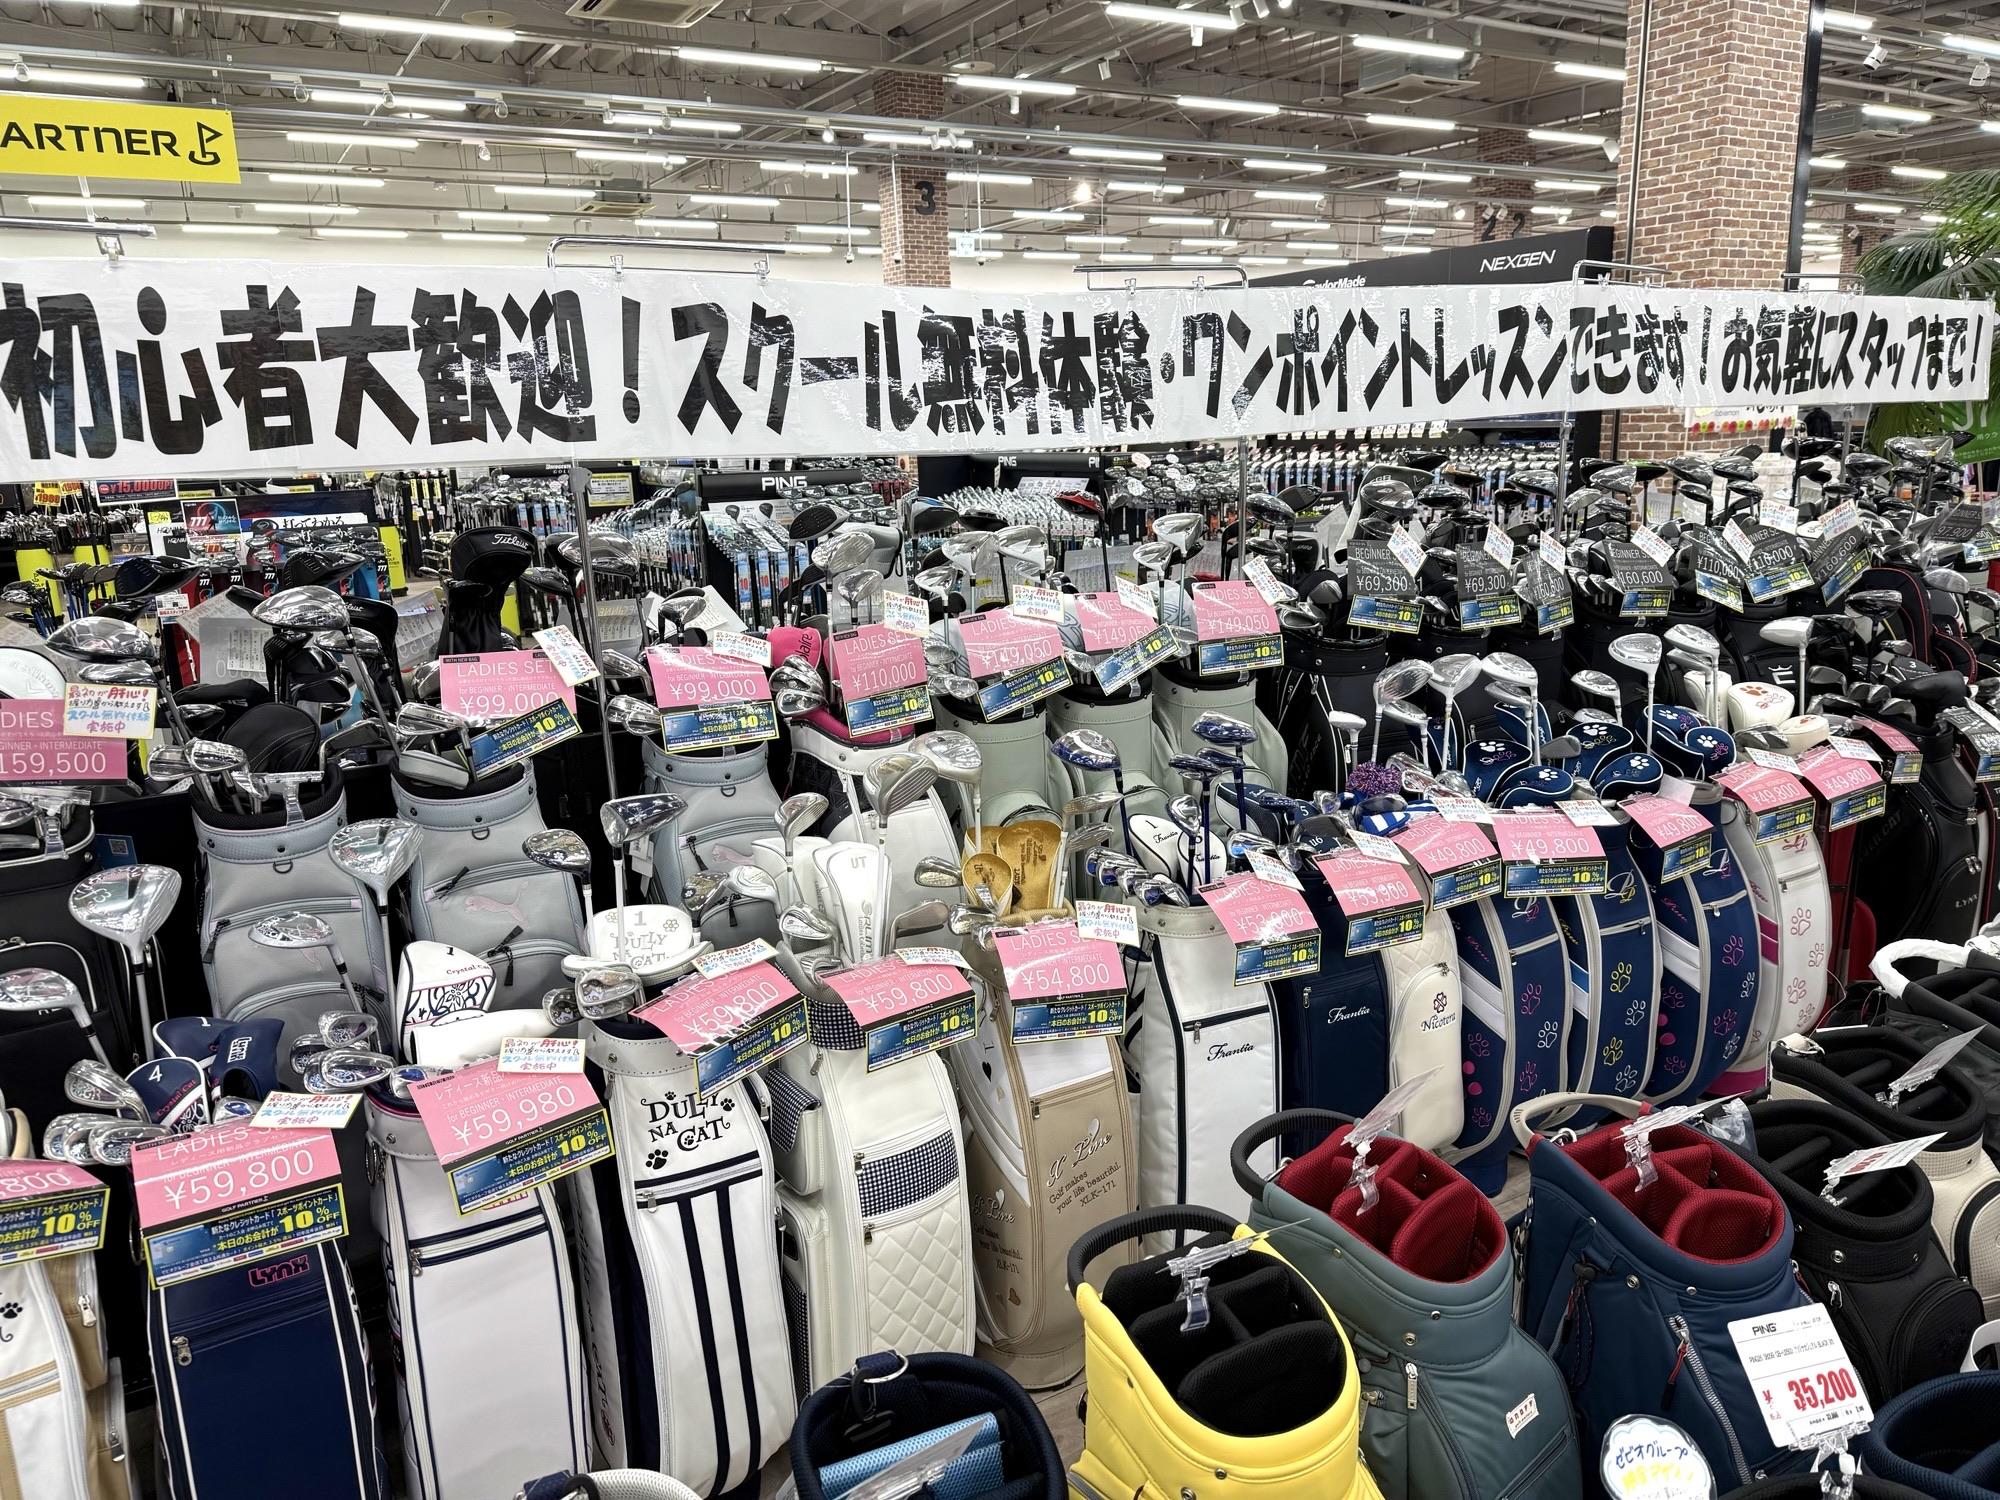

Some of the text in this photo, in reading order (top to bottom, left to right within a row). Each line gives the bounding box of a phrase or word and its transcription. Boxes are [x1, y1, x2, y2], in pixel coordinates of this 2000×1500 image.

[0, 121, 180, 157] ARTNER
[914, 180, 935, 216] 3
[1479, 250, 1556, 272] NEXGEN
[998, 456, 1017, 467] PING
[761, 475, 807, 491] PING
[491, 533, 528, 549] Titleist
[1465, 574, 1507, 593] ¥69,300
[1398, 610, 1412, 621] 10
[1499, 604, 1511, 614] 10
[457, 661, 518, 677] LADIES
[534, 716, 556, 734] 10
[1424, 838, 1486, 867] ¥49,800
[851, 856, 867, 871] UT
[1478, 871, 1491, 885] 10
[1572, 871, 1591, 883] 10
[1399, 919, 1413, 932] 10
[1010, 933, 1067, 951] LADIES
[1291, 948, 1308, 962] 10
[1021, 963, 1110, 991] ¥54,800
[865, 973, 953, 1014] ¥59,800
[940, 1015, 960, 1033] 10
[1087, 1009, 1108, 1024] 10
[1326, 1006, 1370, 1024] Frantia
[1420, 1013, 1456, 1032] Nicotera
[771, 1023, 792, 1043] 10
[1206, 1042, 1255, 1062] Frantia
[149, 1065, 162, 1082] 4
[459, 1097, 500, 1118] BEGINNER
[505, 1075, 563, 1102] INTERMEDIATE
[452, 1085, 576, 1147] ¥59,980
[648, 1120, 678, 1143] NA
[677, 1116, 731, 1152] CAT
[157, 1126, 250, 1161] LADIES
[557, 1134, 586, 1157] 10
[587, 1133, 606, 1146] OFF
[164, 1149, 315, 1211] ¥59,800
[1049, 1171, 1088, 1205] Golf makes
[1056, 1197, 1073, 1214] your
[1073, 1185, 1085, 1199] life
[1081, 1180, 1117, 1208] XLK-171
[42, 1213, 76, 1237] 10
[77, 1219, 100, 1230] OFF
[217, 1225, 280, 1251] 本日のお会計が
[279, 1210, 314, 1234] 10
[317, 1211, 340, 1224] OFF
[248, 1254, 310, 1287] Lynx
[1752, 1322, 1777, 1336] PING
[1787, 1367, 1857, 1411] 35,200
[1616, 1440, 1688, 1469] ゼビオグループ
